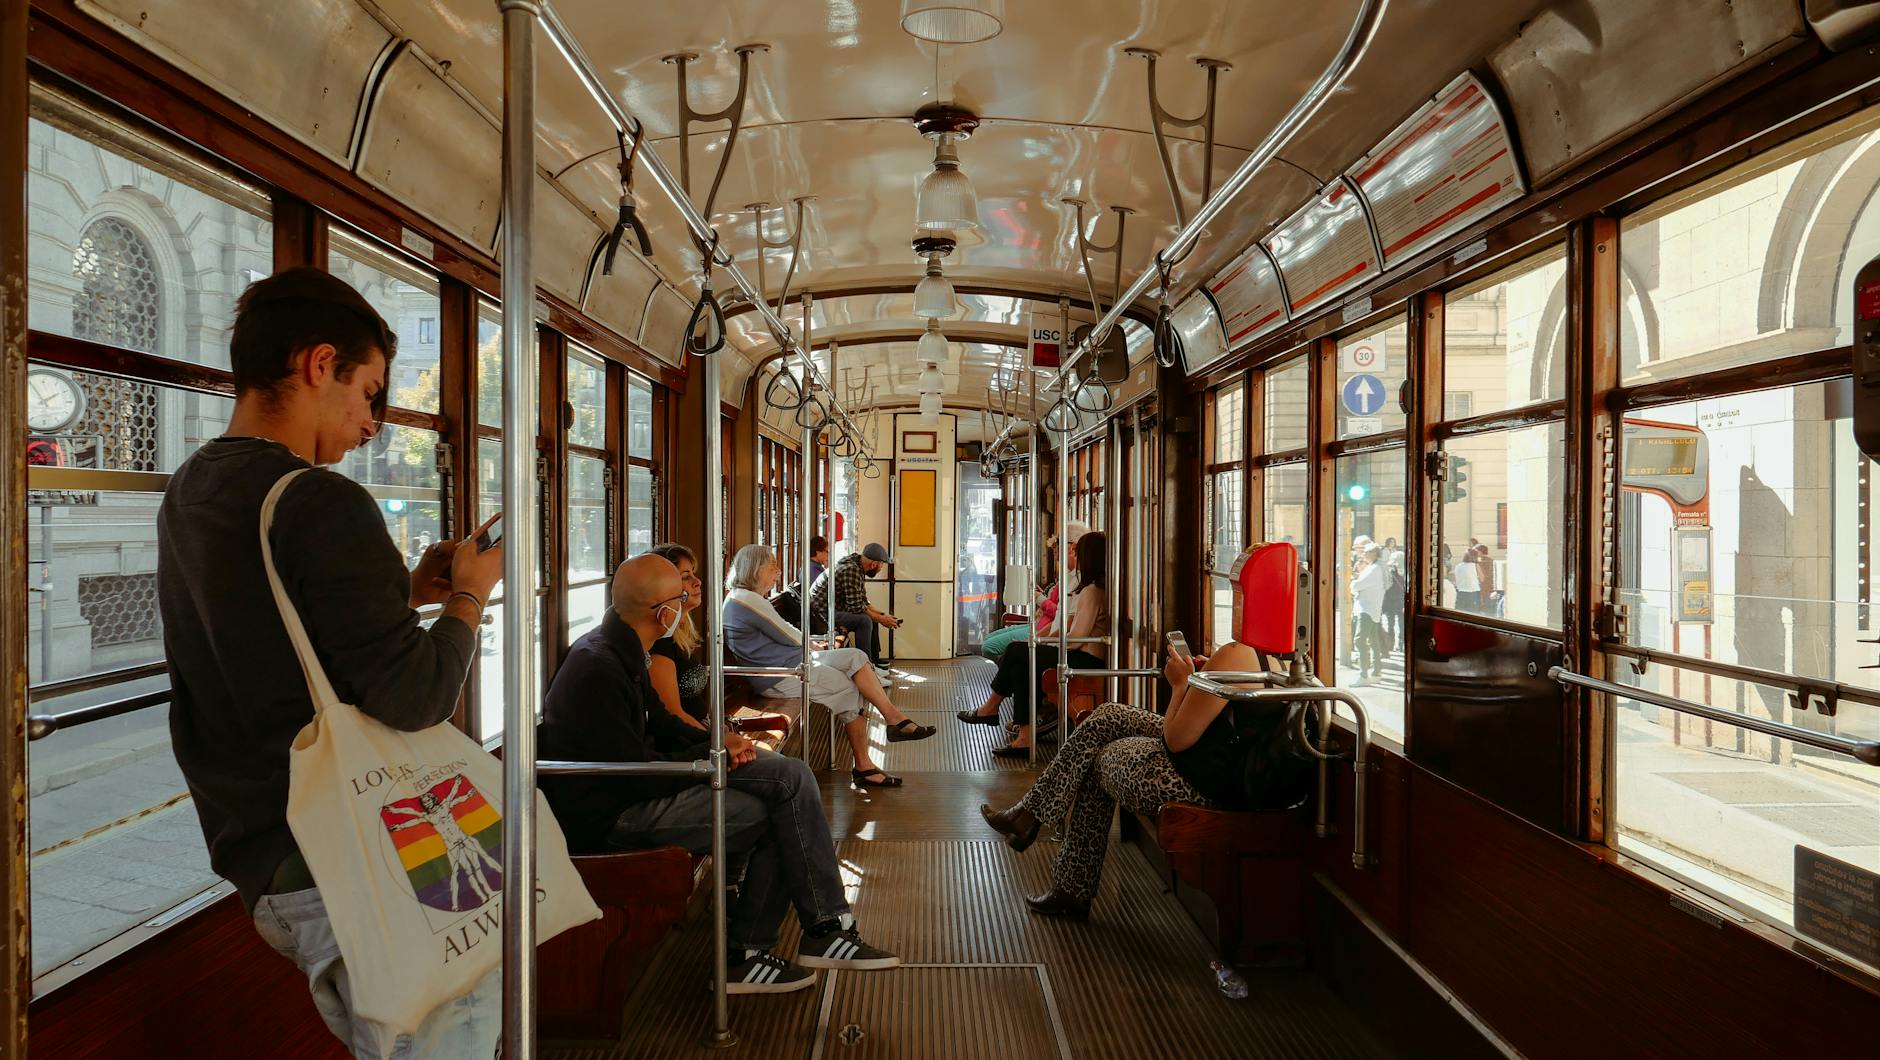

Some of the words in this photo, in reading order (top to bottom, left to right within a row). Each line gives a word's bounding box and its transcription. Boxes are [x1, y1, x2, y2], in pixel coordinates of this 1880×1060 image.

[1034, 329, 1076, 341] usca
[1360, 352, 1370, 361] 30
[444, 878, 547, 964] ALWS
